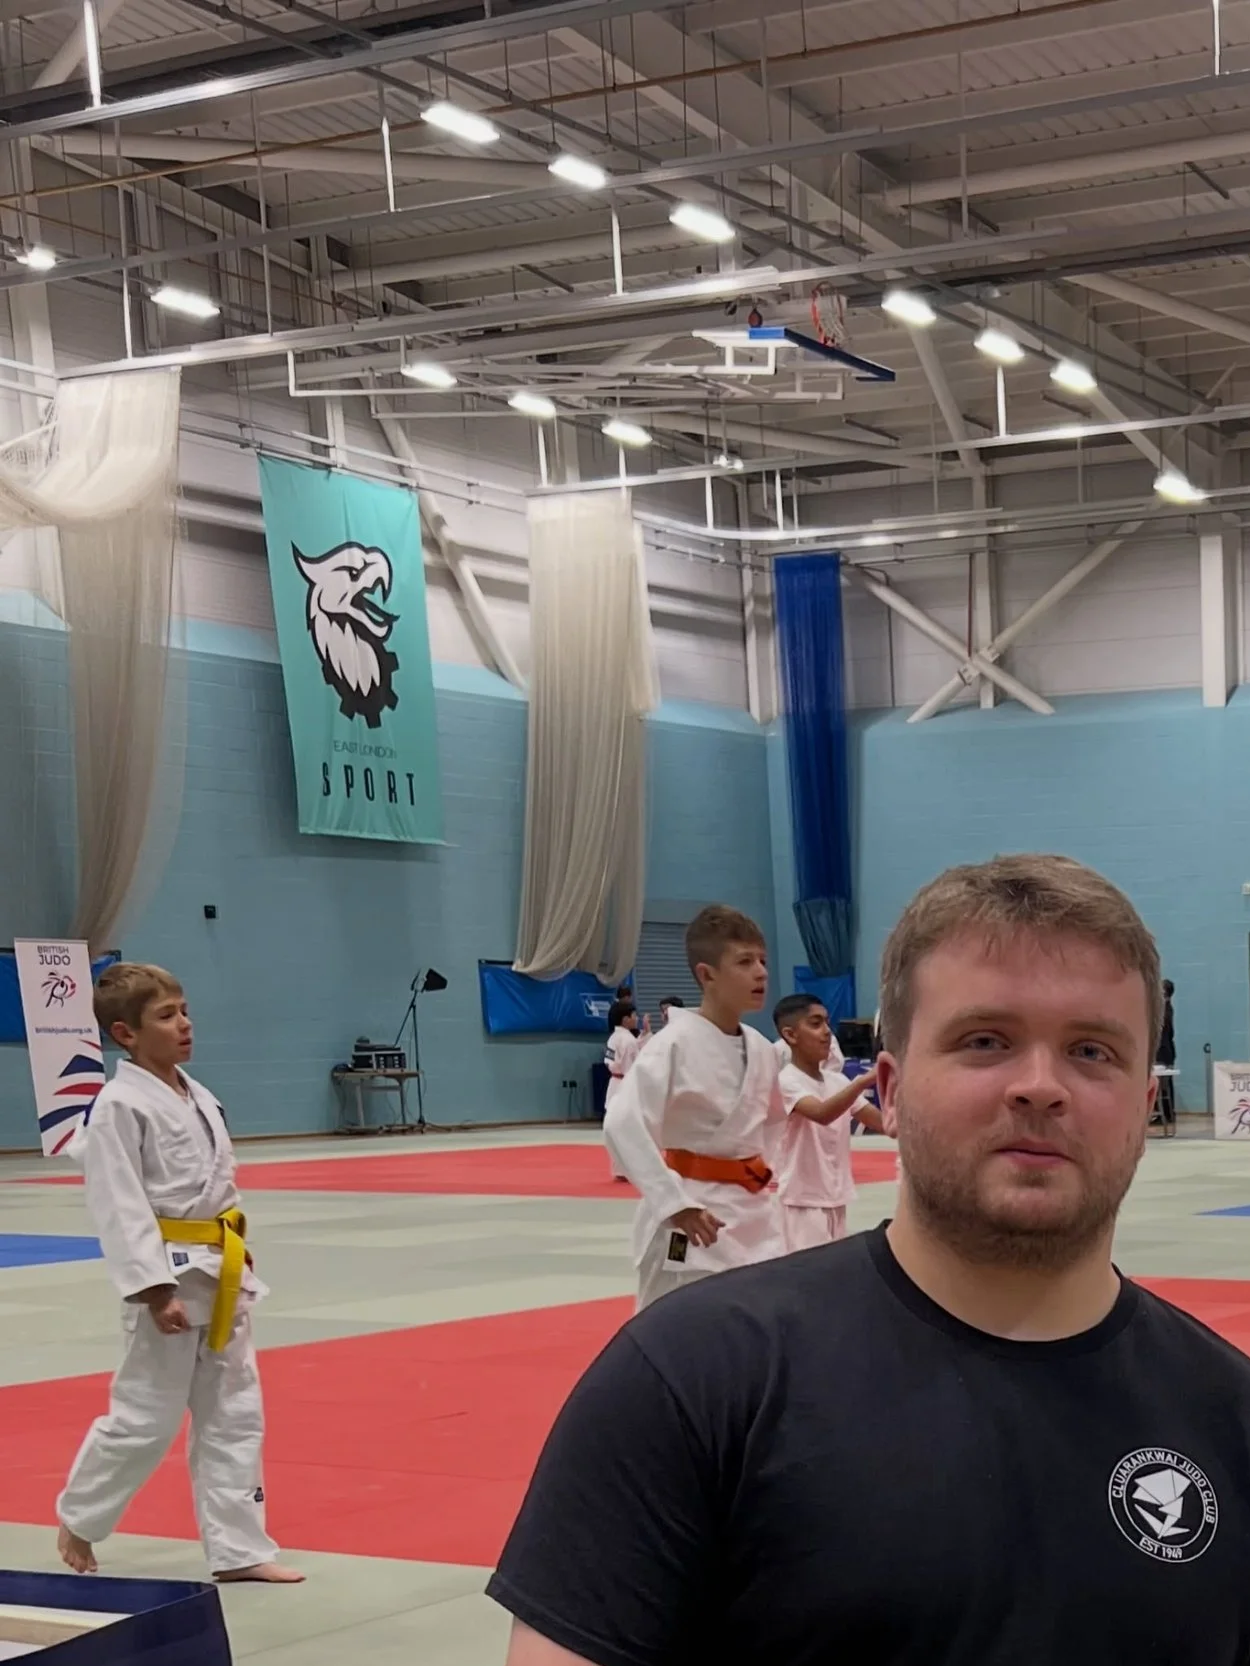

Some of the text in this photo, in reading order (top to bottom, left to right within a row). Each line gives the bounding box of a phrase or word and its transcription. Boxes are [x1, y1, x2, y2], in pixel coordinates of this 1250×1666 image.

[322, 762, 415, 806] SPORT
[37, 946, 70, 954] BRITISH
[39, 954, 71, 966] JUDO
[1179, 1460, 1207, 1488] JUDO
[1202, 1489, 1217, 1525] CLUB
[1139, 1536, 1160, 1554] EST
